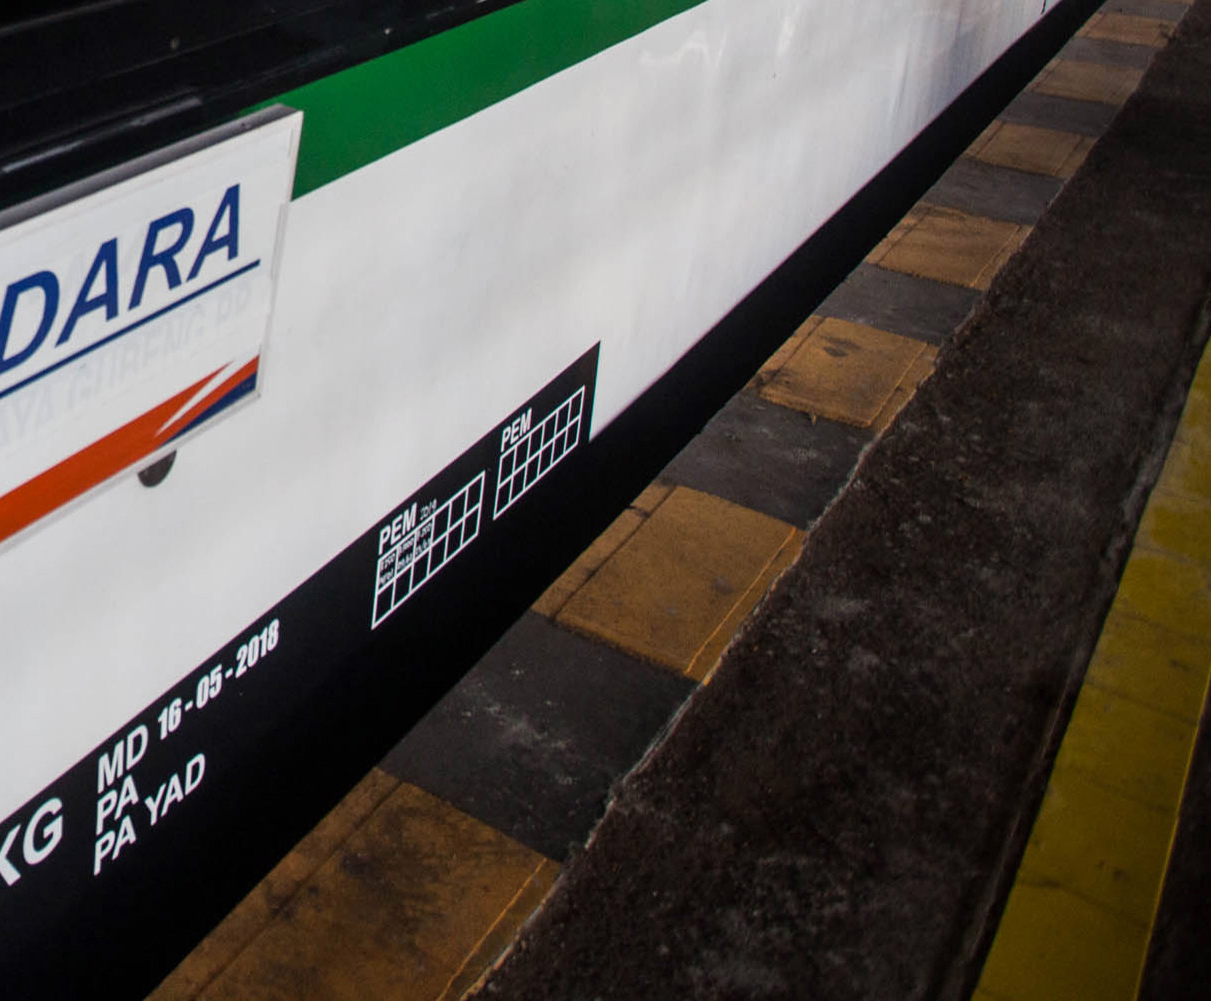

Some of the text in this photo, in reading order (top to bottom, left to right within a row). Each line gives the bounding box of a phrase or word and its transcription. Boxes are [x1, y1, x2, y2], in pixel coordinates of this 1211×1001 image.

[501, 408, 532, 453] PEM
[378, 502, 418, 556] PEM
[96, 724, 148, 794] MD
[93, 752, 206, 876] PA YAD
[95, 774, 139, 835] PA
